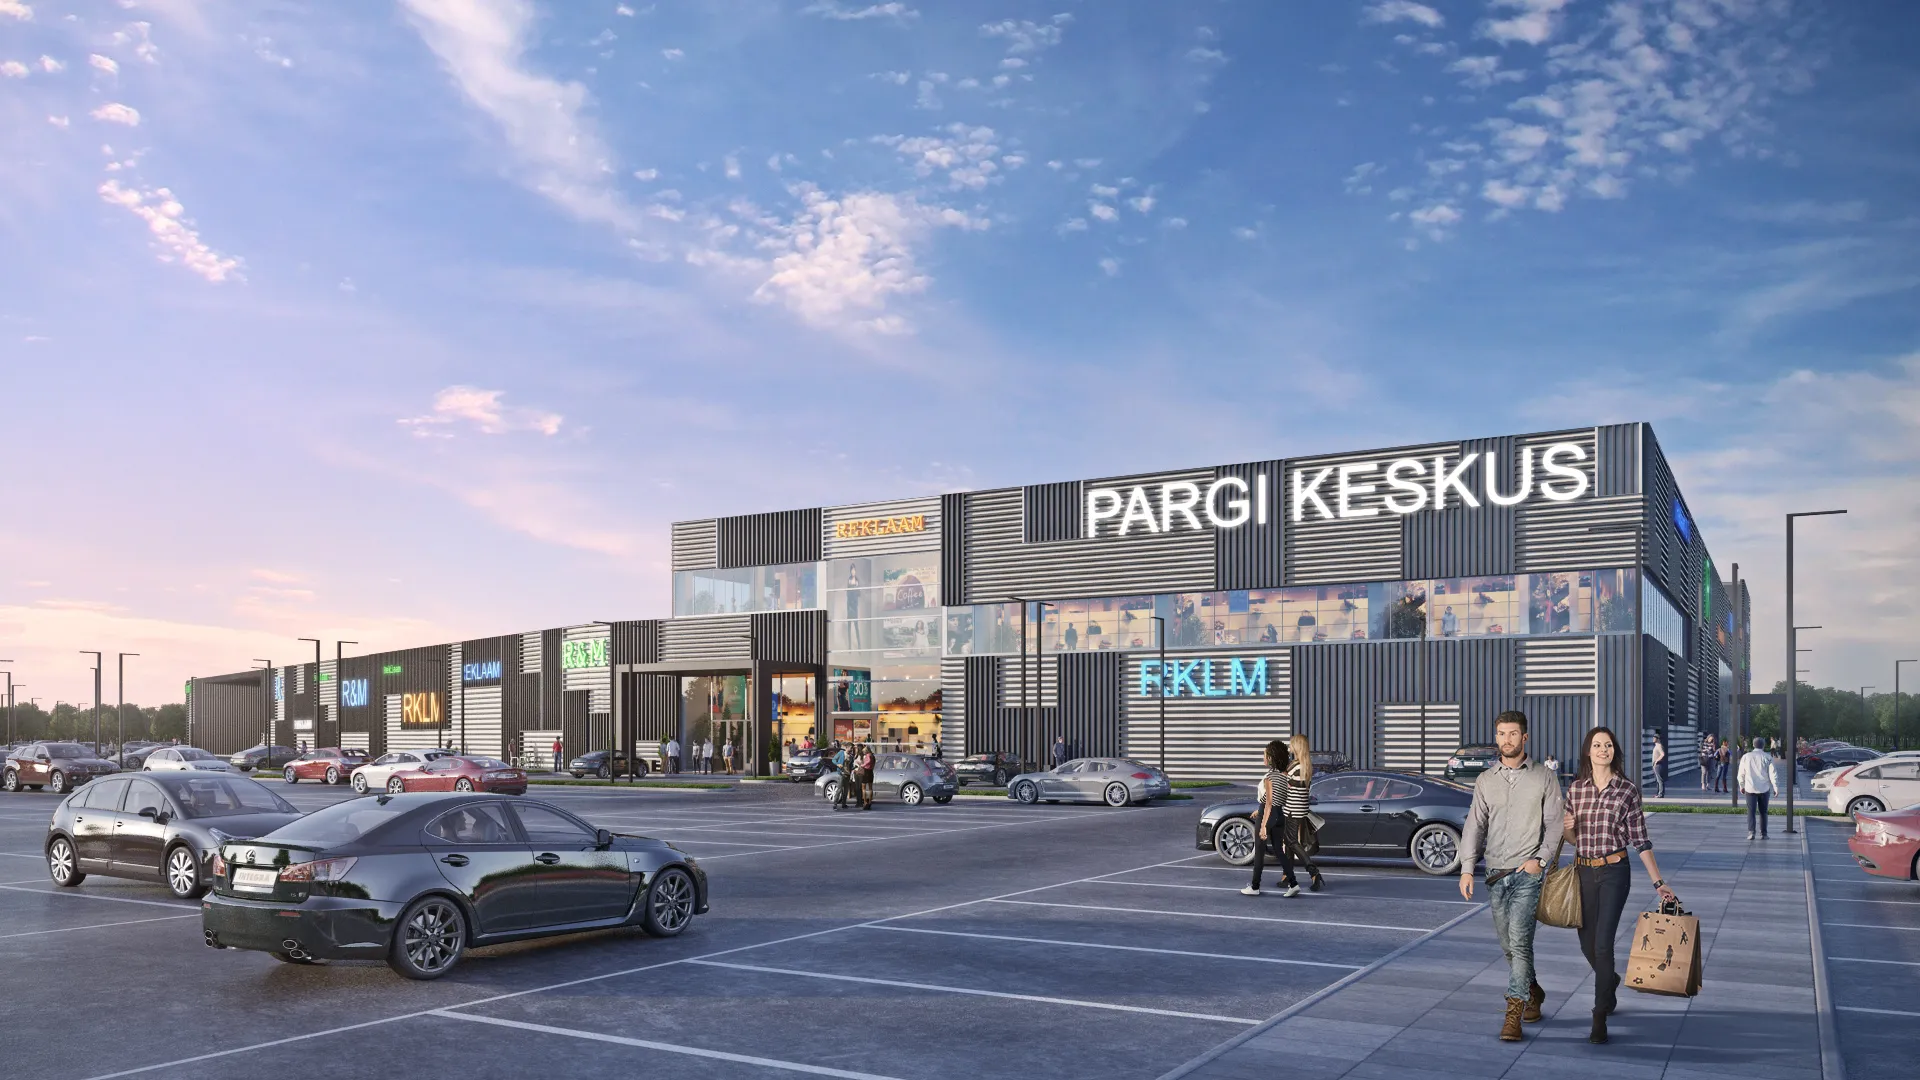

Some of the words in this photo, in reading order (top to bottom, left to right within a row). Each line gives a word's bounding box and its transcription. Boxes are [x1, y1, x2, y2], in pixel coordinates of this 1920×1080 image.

[1087, 474, 1267, 539] PARGI
[1292, 442, 1590, 523] KESKUS
[836, 514, 925, 538] REKLAAM
[563, 638, 609, 668] R&M
[1140, 656, 1269, 696] RKLM
[342, 679, 367, 706] R&M
